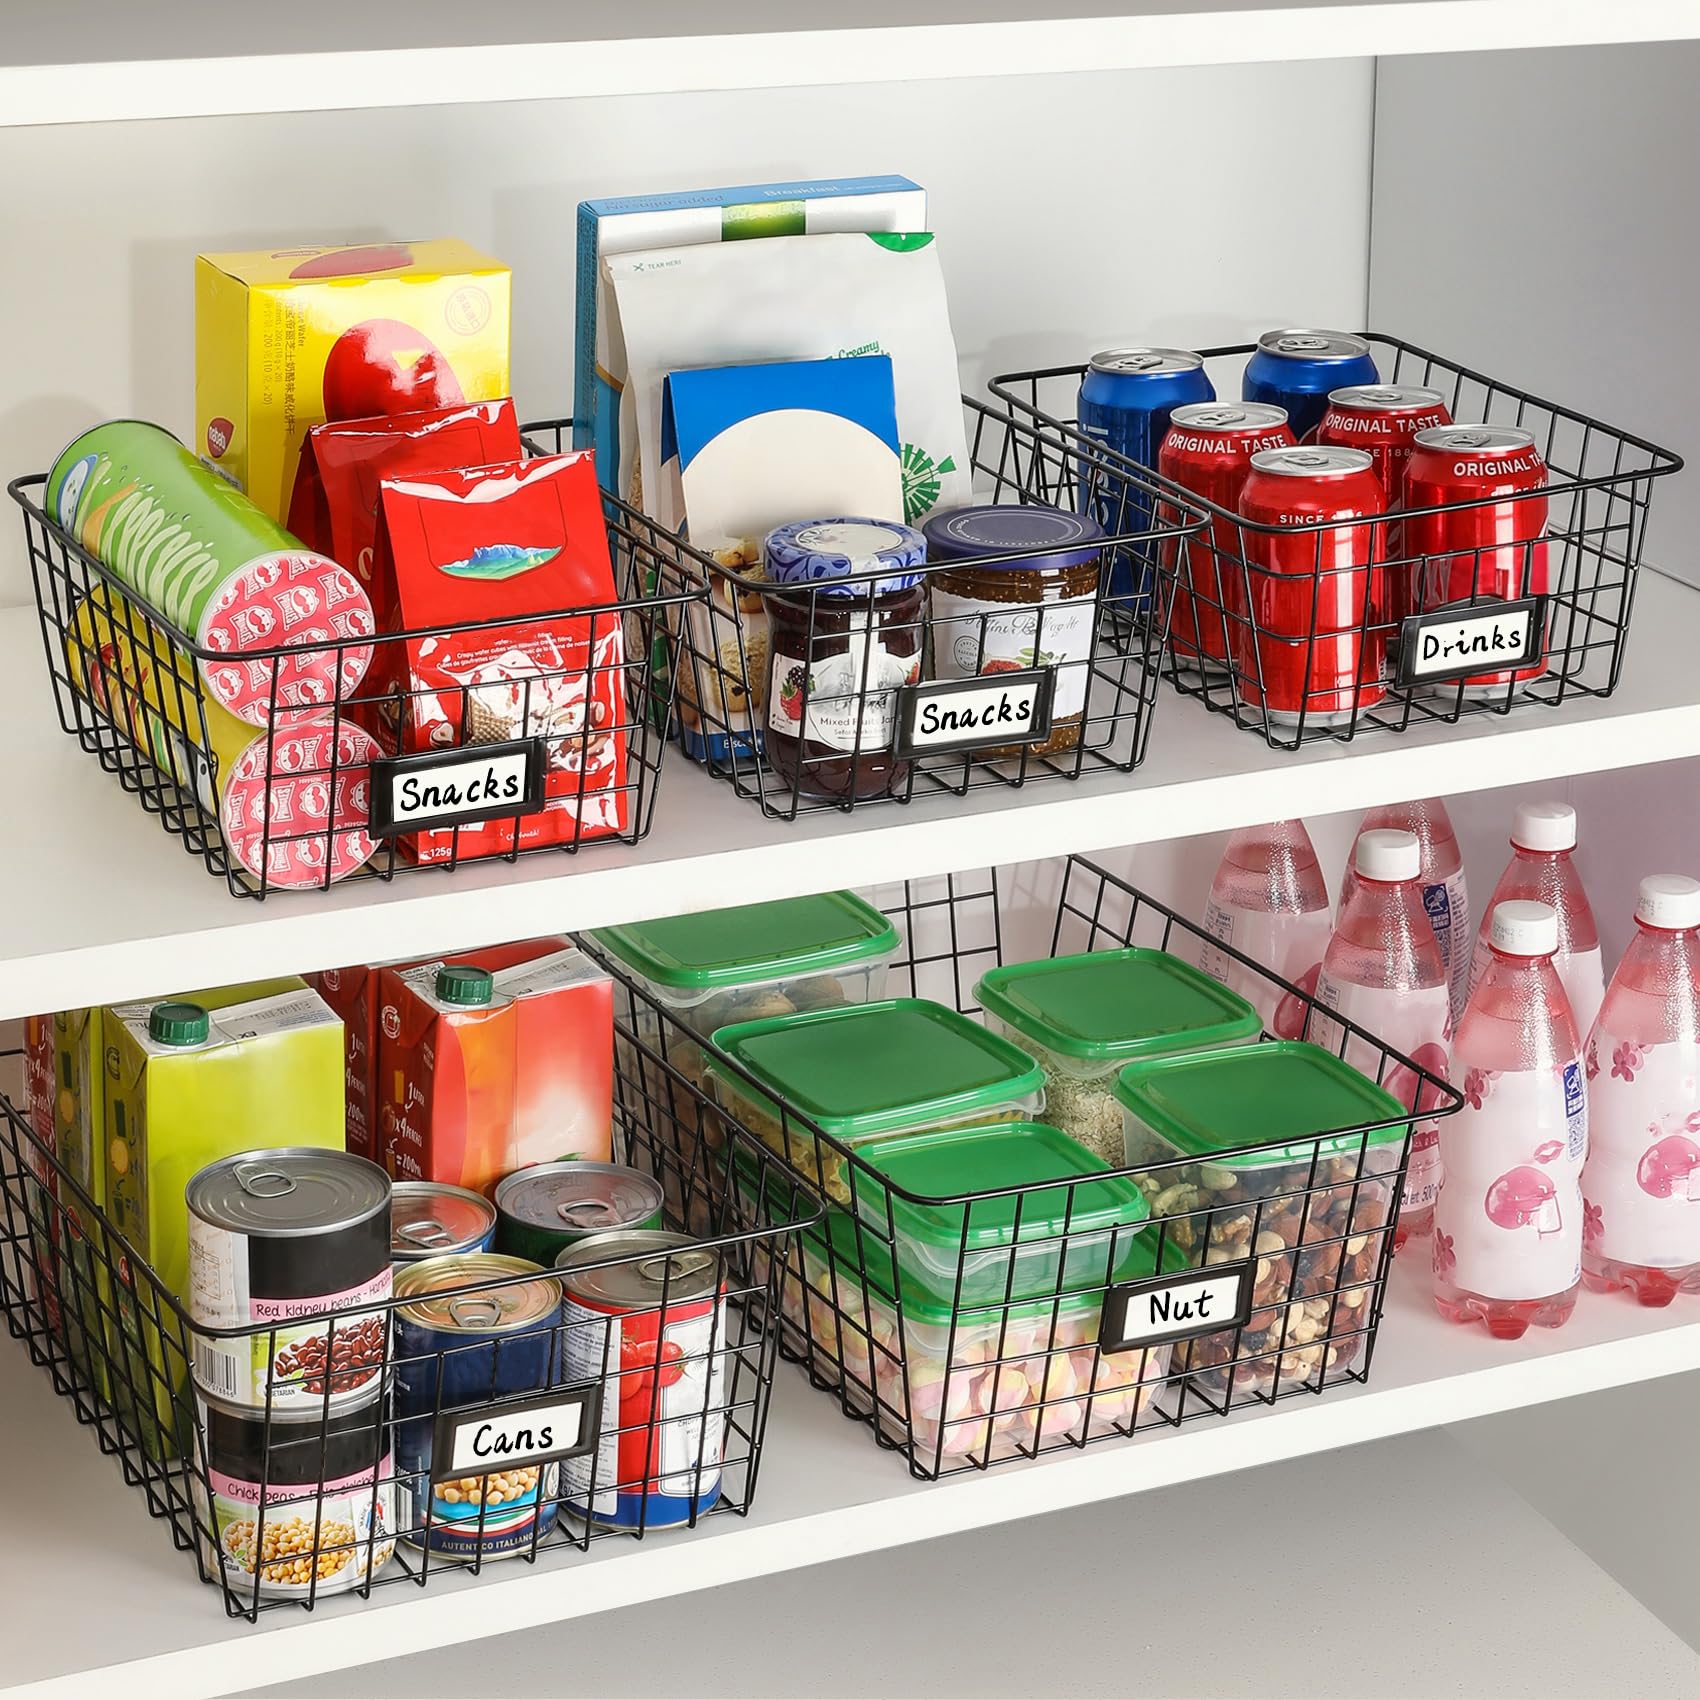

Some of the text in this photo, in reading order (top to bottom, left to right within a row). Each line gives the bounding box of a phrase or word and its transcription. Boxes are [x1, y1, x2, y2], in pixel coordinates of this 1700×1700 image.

[765, 184, 840, 197] Breakfast
[838, 340, 880, 359] Creamy
[1326, 414, 1442, 433] ORIGINAL TASTE
[1167, 433, 1287, 454] ORIGINAL TASTE
[1453, 457, 1531, 477] ORIGINAL
[1279, 514, 1325, 524] SINCE
[1423, 624, 1521, 661] Drinks
[820, 717, 850, 726] Mixed
[920, 692, 1031, 734] Snacks
[400, 767, 519, 812] Snacks
[430, 846, 452, 858] 125g
[256, 1303, 280, 1317] Red
[1150, 1289, 1214, 1325] Nut
[473, 1424, 553, 1457] Cans
[227, 1482, 259, 1501] Chick
[441, 1541, 493, 1551] AUTENTCO
[496, 1532, 534, 1549] ITALIANO
